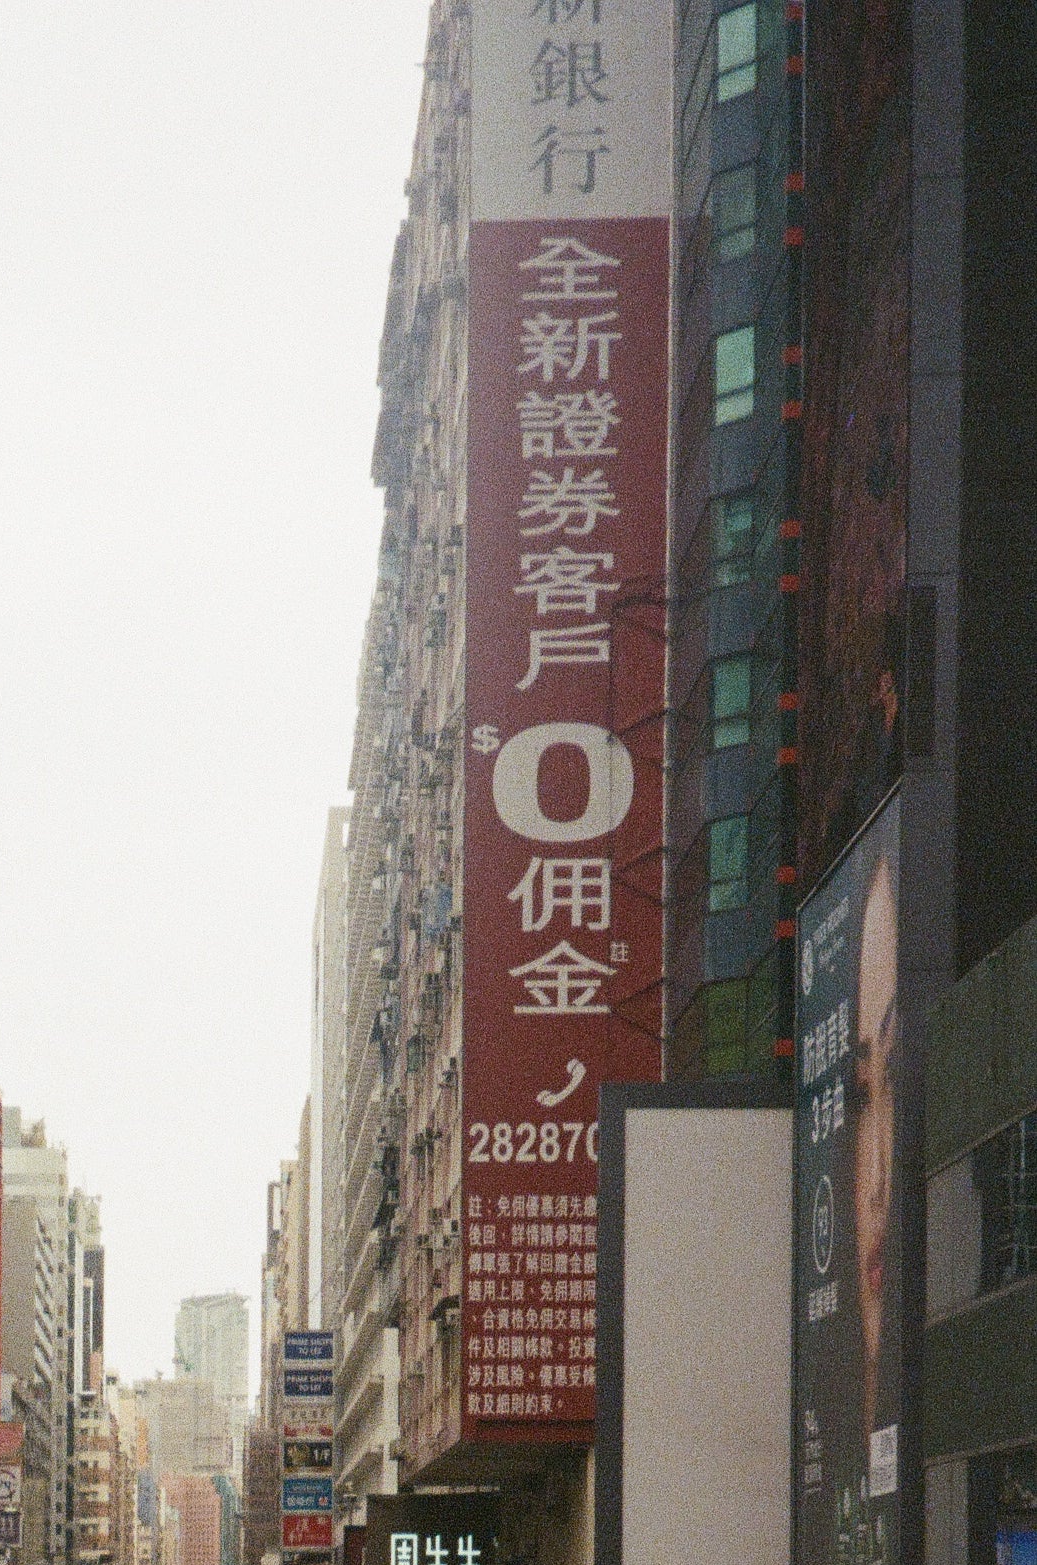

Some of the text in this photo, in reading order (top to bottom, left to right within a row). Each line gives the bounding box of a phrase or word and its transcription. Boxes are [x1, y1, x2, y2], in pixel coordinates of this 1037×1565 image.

[514, 237, 622, 691] 全新證券客戶
[507, 856, 617, 1015] 佣金
